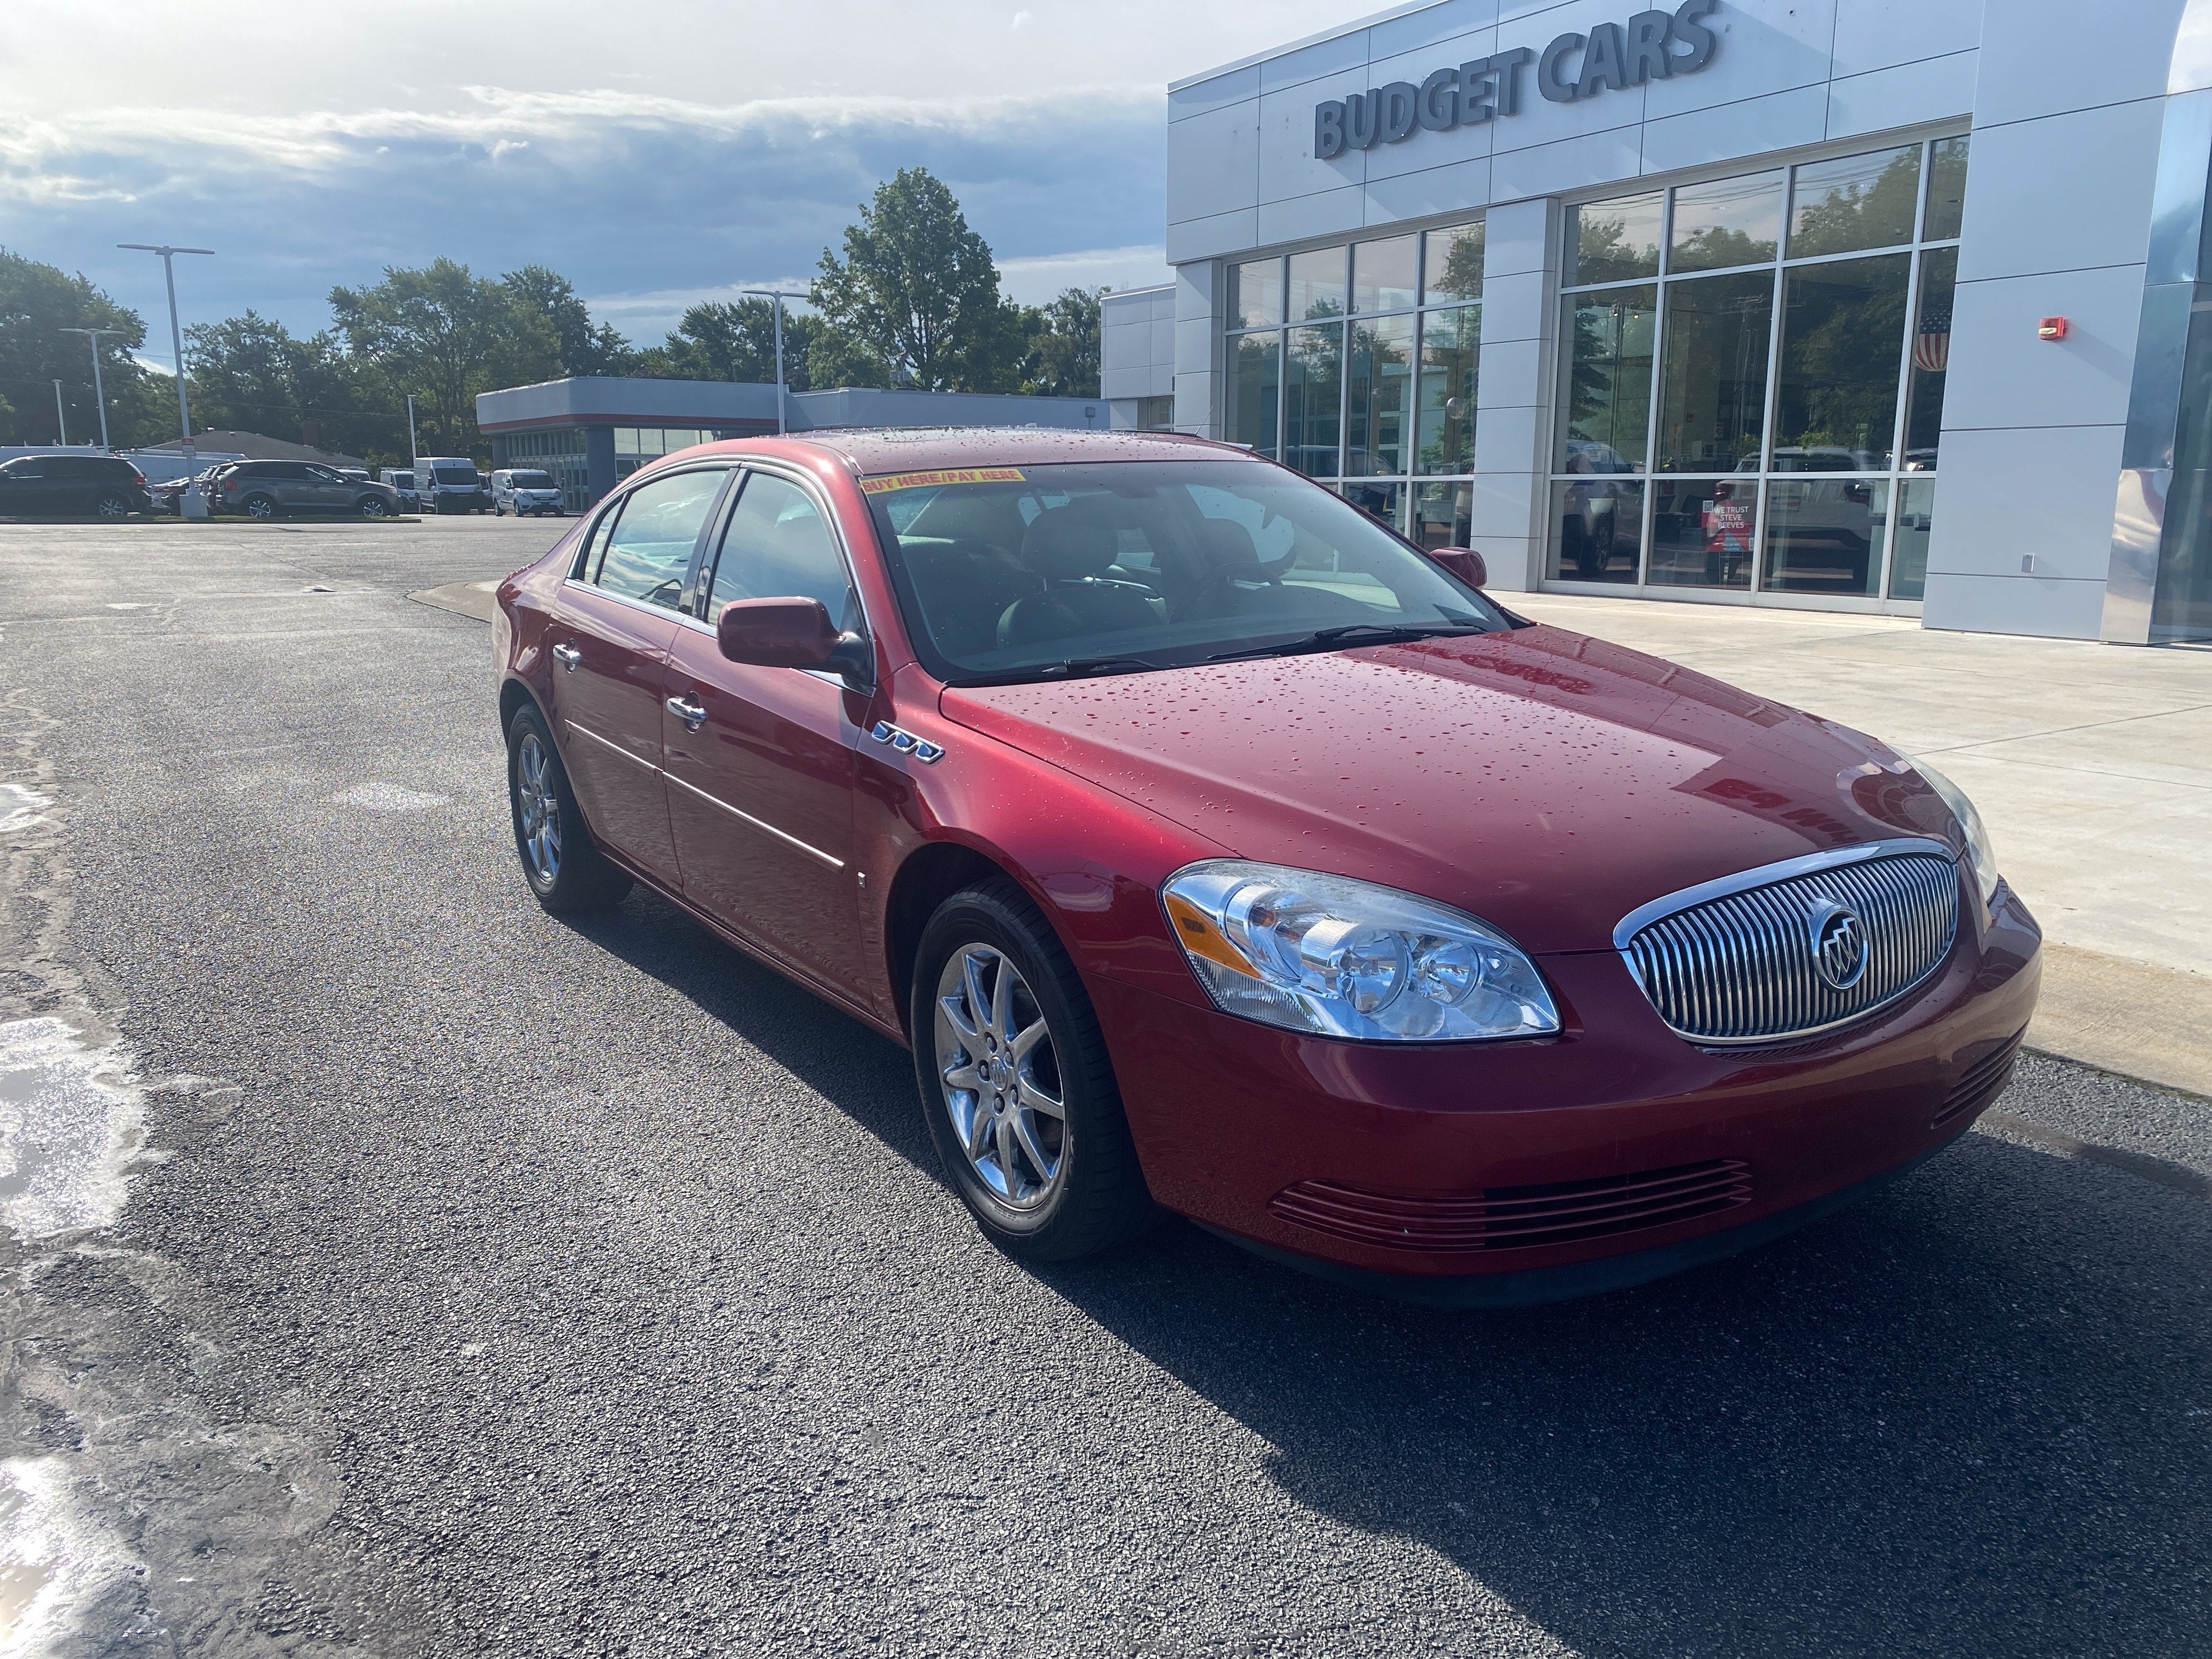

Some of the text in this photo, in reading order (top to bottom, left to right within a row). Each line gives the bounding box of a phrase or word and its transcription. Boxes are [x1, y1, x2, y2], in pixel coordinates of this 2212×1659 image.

[1315, 0, 1717, 159] BUDGET CARS
[862, 478, 893, 492] BUY
